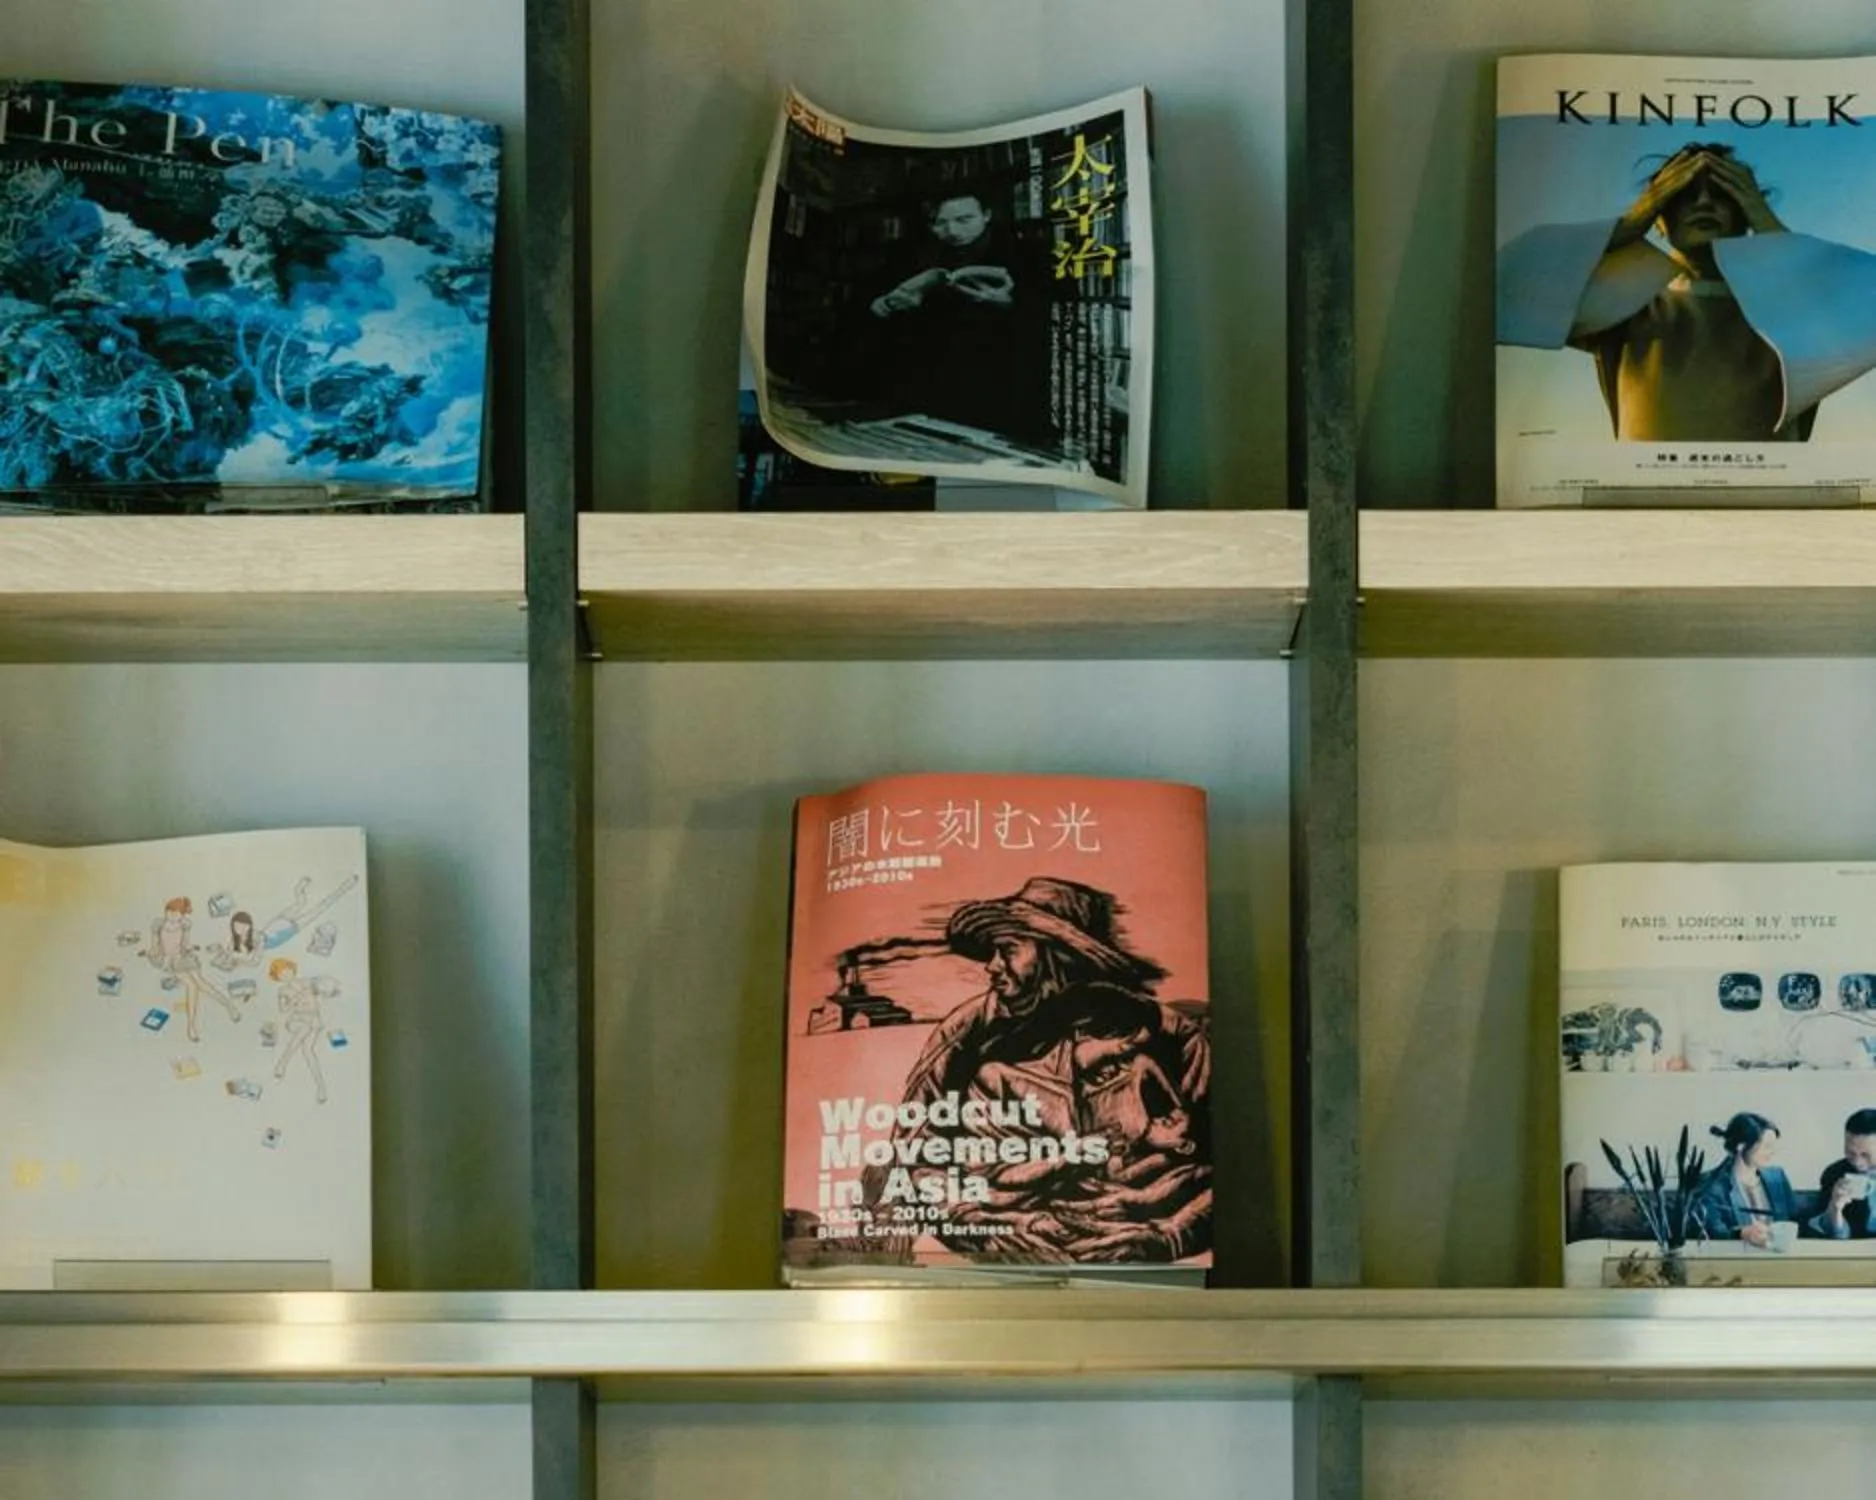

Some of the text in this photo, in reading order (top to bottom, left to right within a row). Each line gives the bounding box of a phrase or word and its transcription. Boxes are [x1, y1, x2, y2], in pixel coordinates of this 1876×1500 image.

[1556, 91, 1863, 128] KINFOLK
[165, 111, 297, 166] Pen
[1050, 134, 1116, 280] 太宰治
[828, 799, 1103, 867] 闇に刻む光
[1791, 917, 1838, 928] STYLE
[818, 1091, 1042, 1133] Woodcut
[818, 1131, 1109, 1168] Movements
[818, 1167, 990, 1207] in Asia
[863, 1224, 919, 1237] Carved
[941, 1223, 1015, 1237] Darkness
[892, 1206, 950, 1221] 2010s
